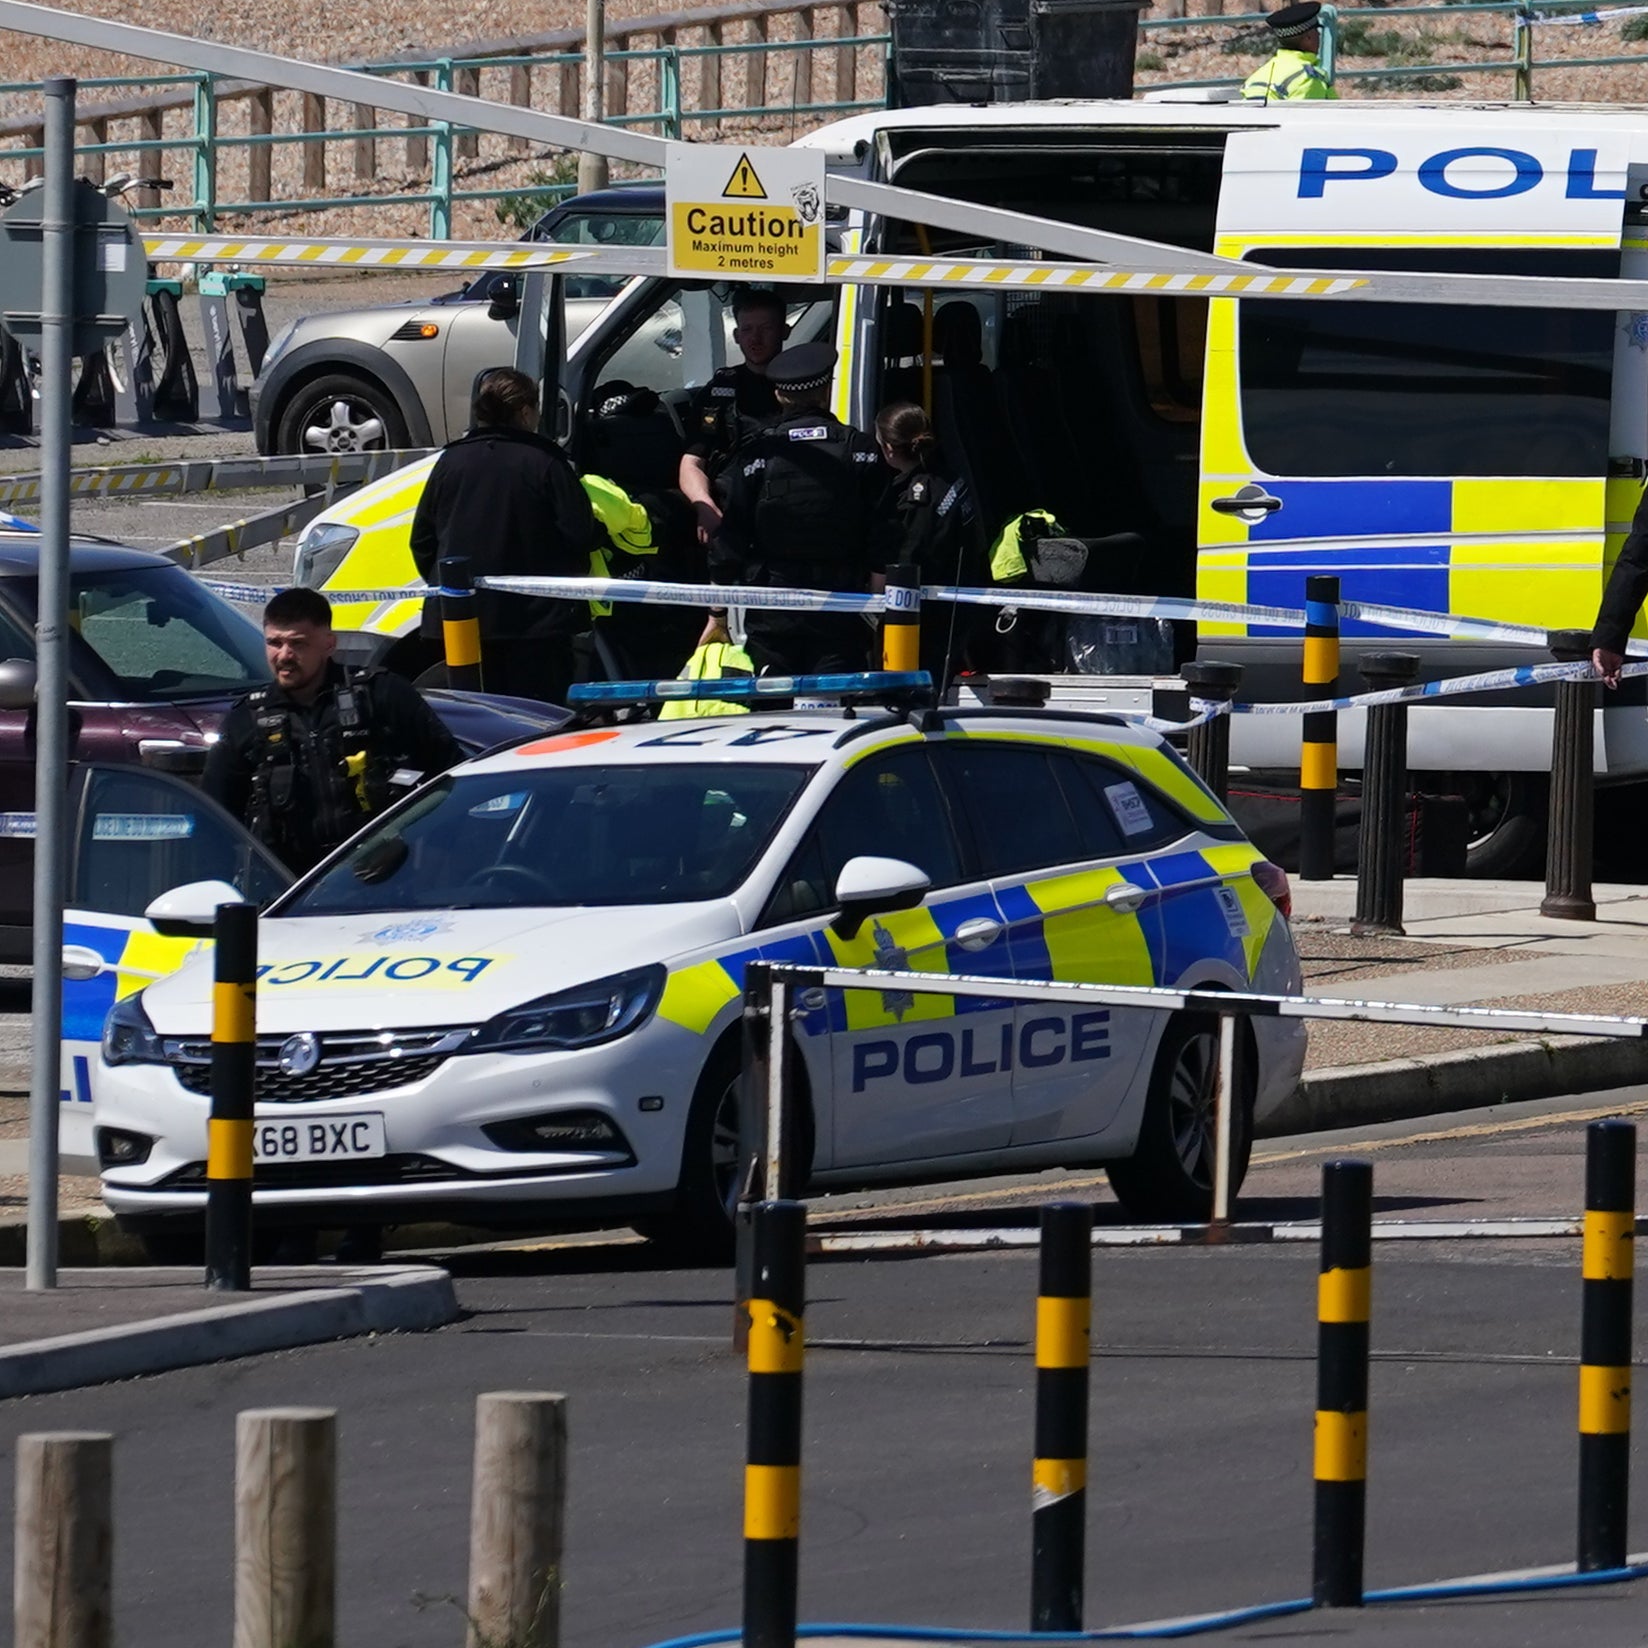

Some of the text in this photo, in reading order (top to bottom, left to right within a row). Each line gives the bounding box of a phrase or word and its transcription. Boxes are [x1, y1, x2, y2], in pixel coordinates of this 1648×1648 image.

[687, 208, 804, 238] Caution
[692, 240, 799, 257] Maximum height
[718, 256, 774, 269] 2 metres
[852, 1009, 1111, 1094] POLICE
[308, 1121, 371, 1155] BXC
